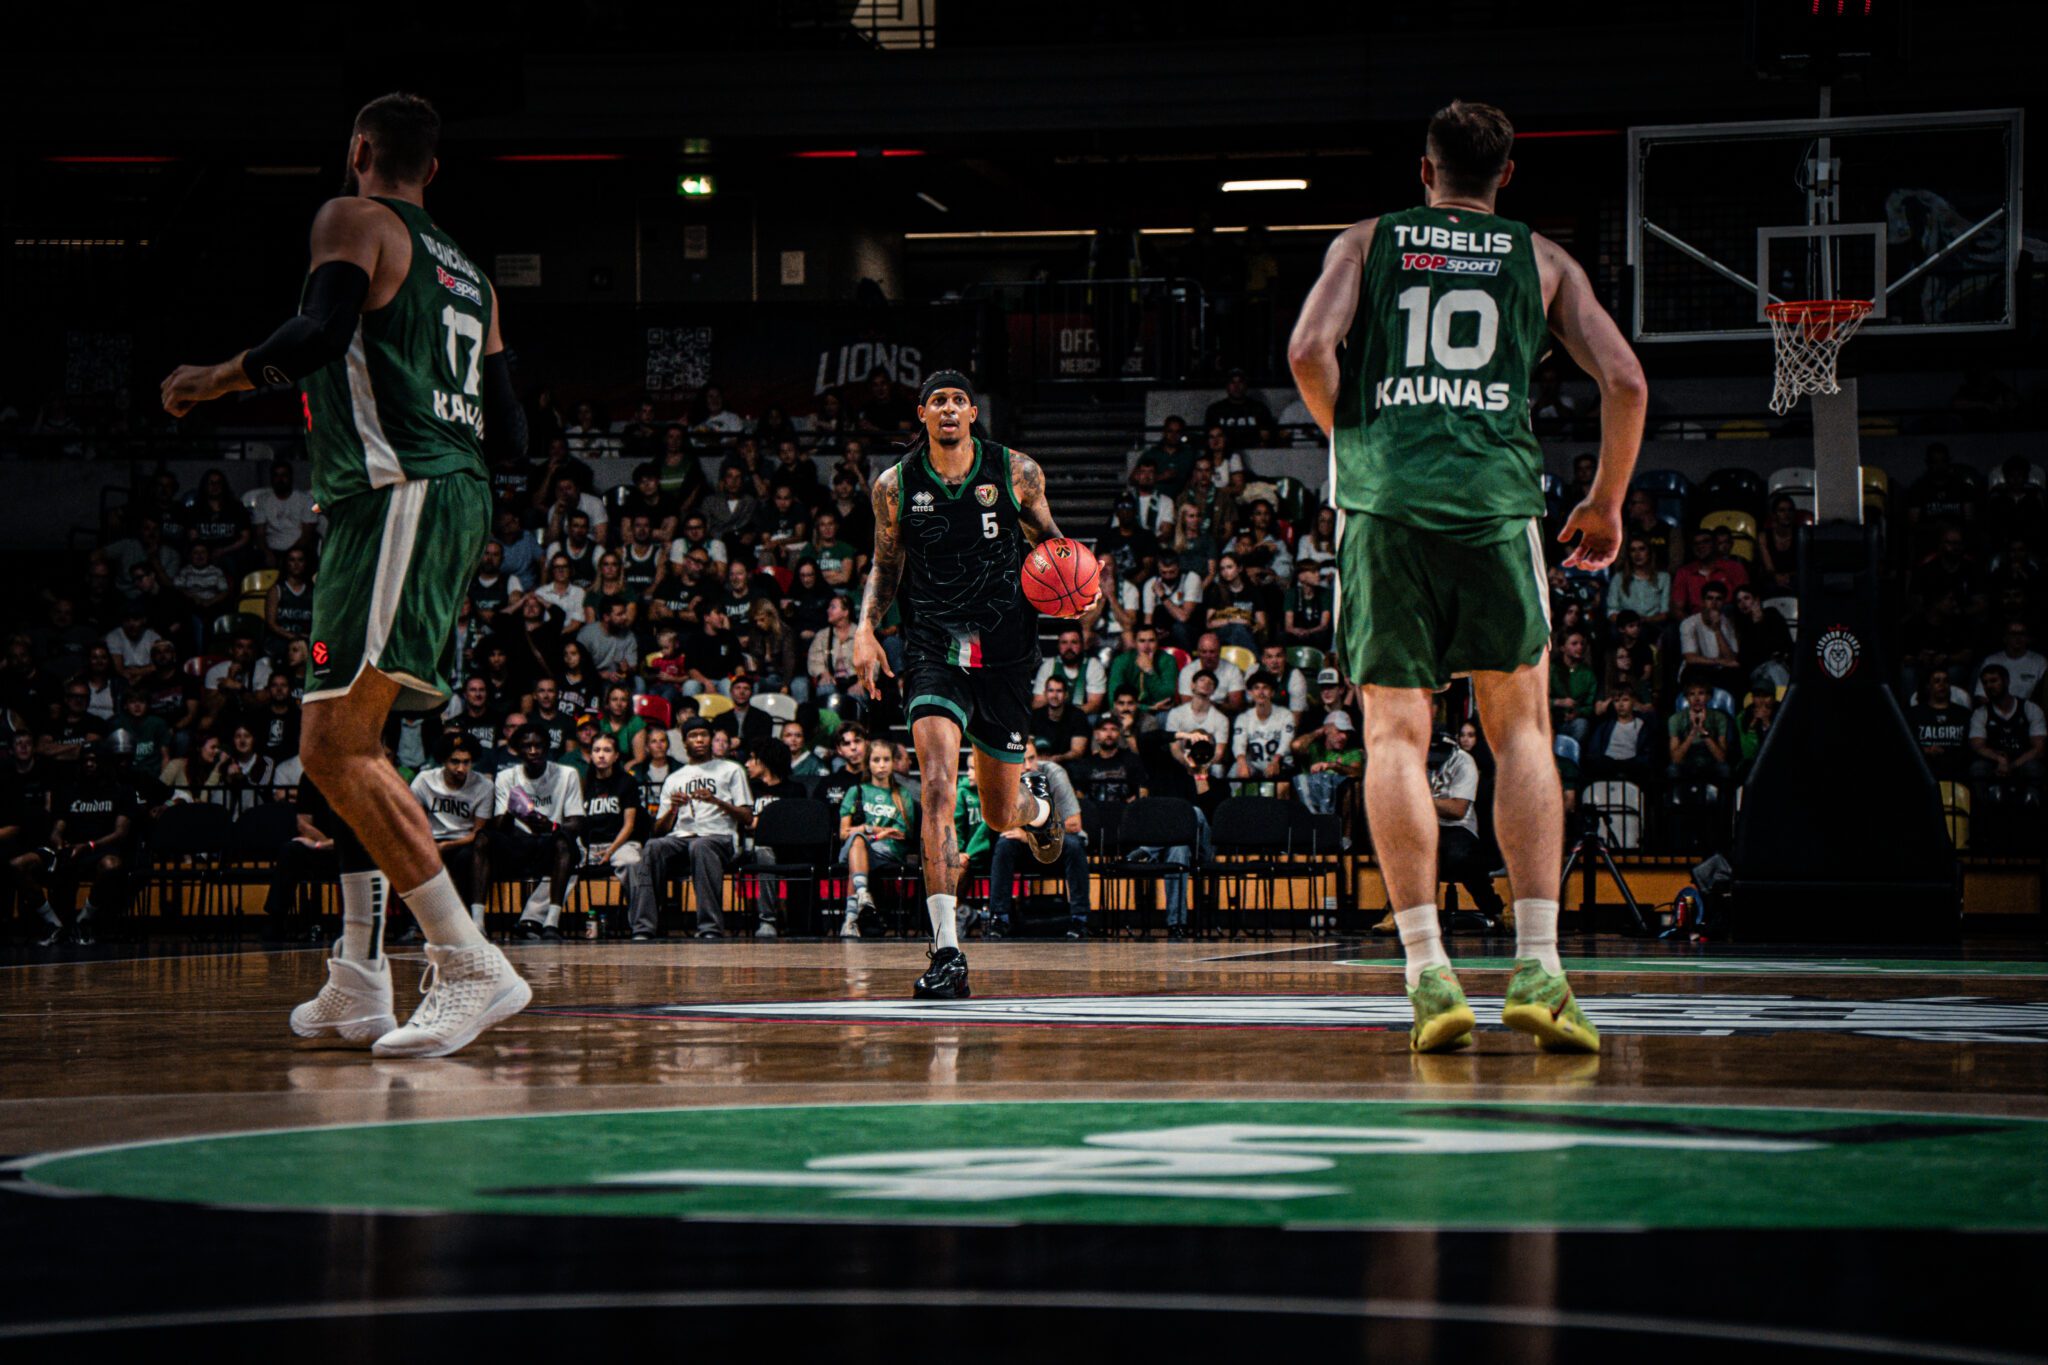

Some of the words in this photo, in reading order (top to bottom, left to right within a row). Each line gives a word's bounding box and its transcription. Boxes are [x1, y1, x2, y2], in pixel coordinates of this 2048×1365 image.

[1394, 225, 1513, 254] TUBELIS
[1398, 286, 1500, 370] 10
[442, 304, 483, 396] 17
[814, 341, 922, 396] LIONS
[1375, 375, 1510, 411] KAUNAS
[981, 512, 999, 539] 5
[69, 799, 114, 814] London
[431, 797, 471, 819] LIONS
[584, 796, 621, 816] IONS
